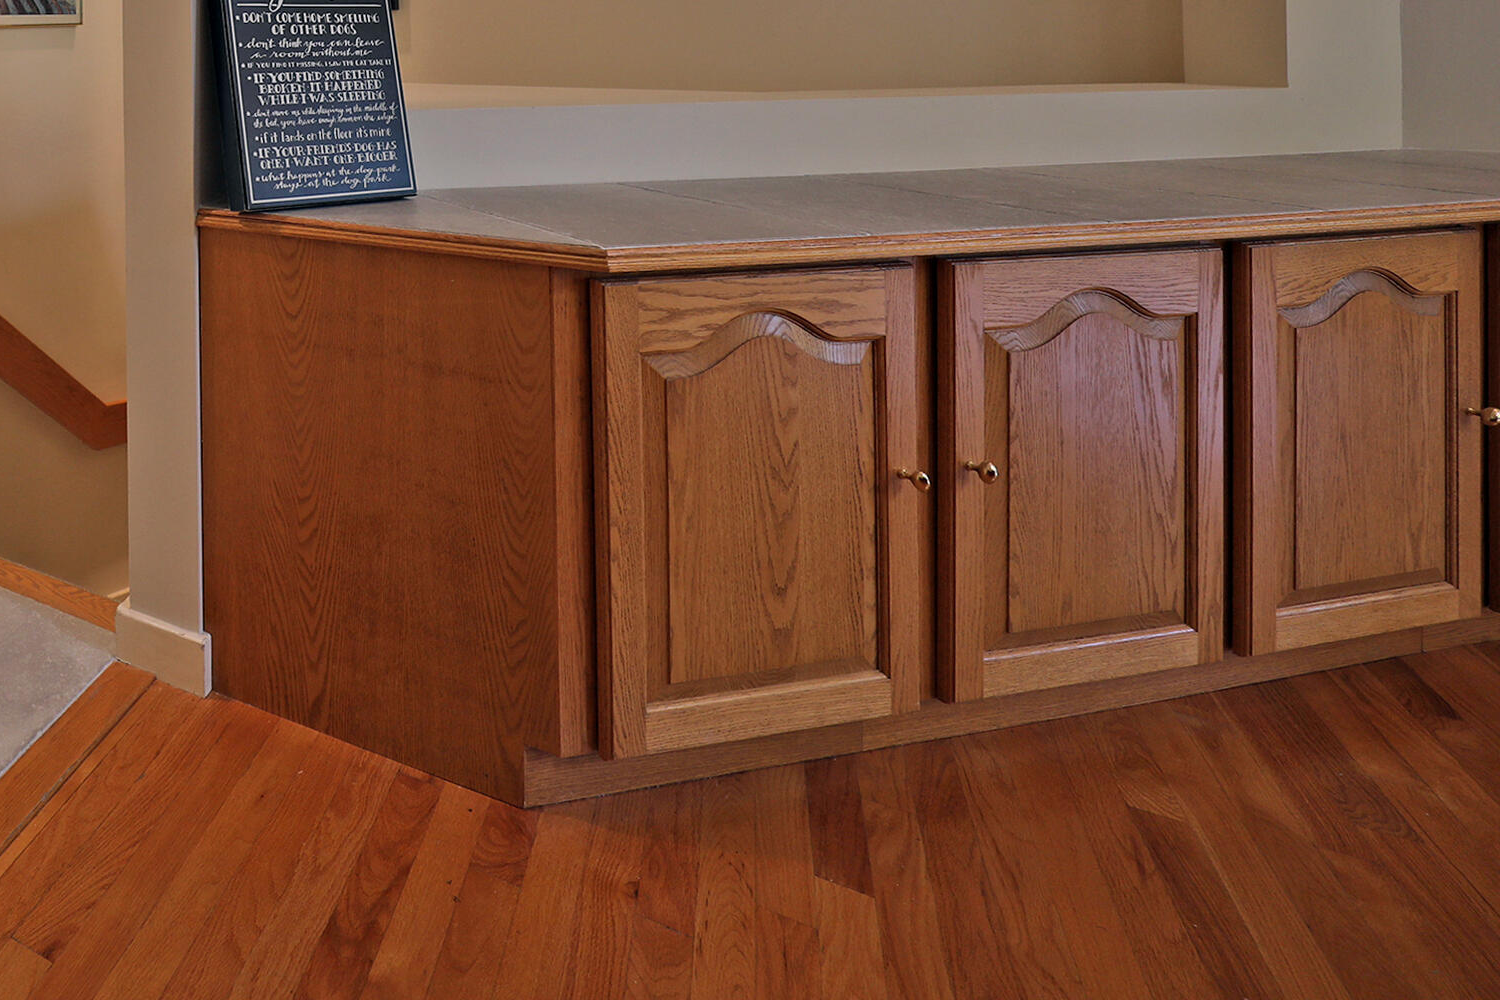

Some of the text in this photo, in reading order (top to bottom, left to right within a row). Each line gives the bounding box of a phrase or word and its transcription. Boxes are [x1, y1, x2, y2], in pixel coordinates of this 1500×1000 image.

[242, 12, 380, 23] DON'T COME HOME SMELLING
[271, 24, 357, 35] OF OTHER DOGS
[244, 37, 276, 50] don't
[279, 37, 302, 48] think
[303, 39, 325, 53] you
[353, 37, 384, 48] leave
[269, 51, 307, 59] room
[311, 46, 352, 57] without
[253, 69, 385, 84] IF YOU FIND SOMETHING
[259, 80, 382, 94] BROKEN IT HAPPENED
[257, 90, 386, 106] WHILE I WAS SLEEPING
[260, 131, 269, 143] if
[270, 131, 278, 143] it
[281, 130, 305, 142] lands
[318, 128, 332, 140] the
[334, 127, 352, 140] floor
[370, 127, 392, 137] mine
[258, 147, 270, 158] IF
[272, 146, 305, 158] YOUR
[354, 141, 374, 152] DOG
[376, 140, 397, 151] HAS
[284, 158, 291, 168] I
[292, 156, 330, 167] WANT
[333, 153, 355, 164] ONE
[357, 151, 398, 163] BIGGER
[261, 172, 286, 182] what
[287, 170, 323, 183] happens
[355, 165, 373, 179] dog
[273, 180, 303, 193] stays
[322, 177, 339, 187] the
[341, 176, 361, 190] dog
